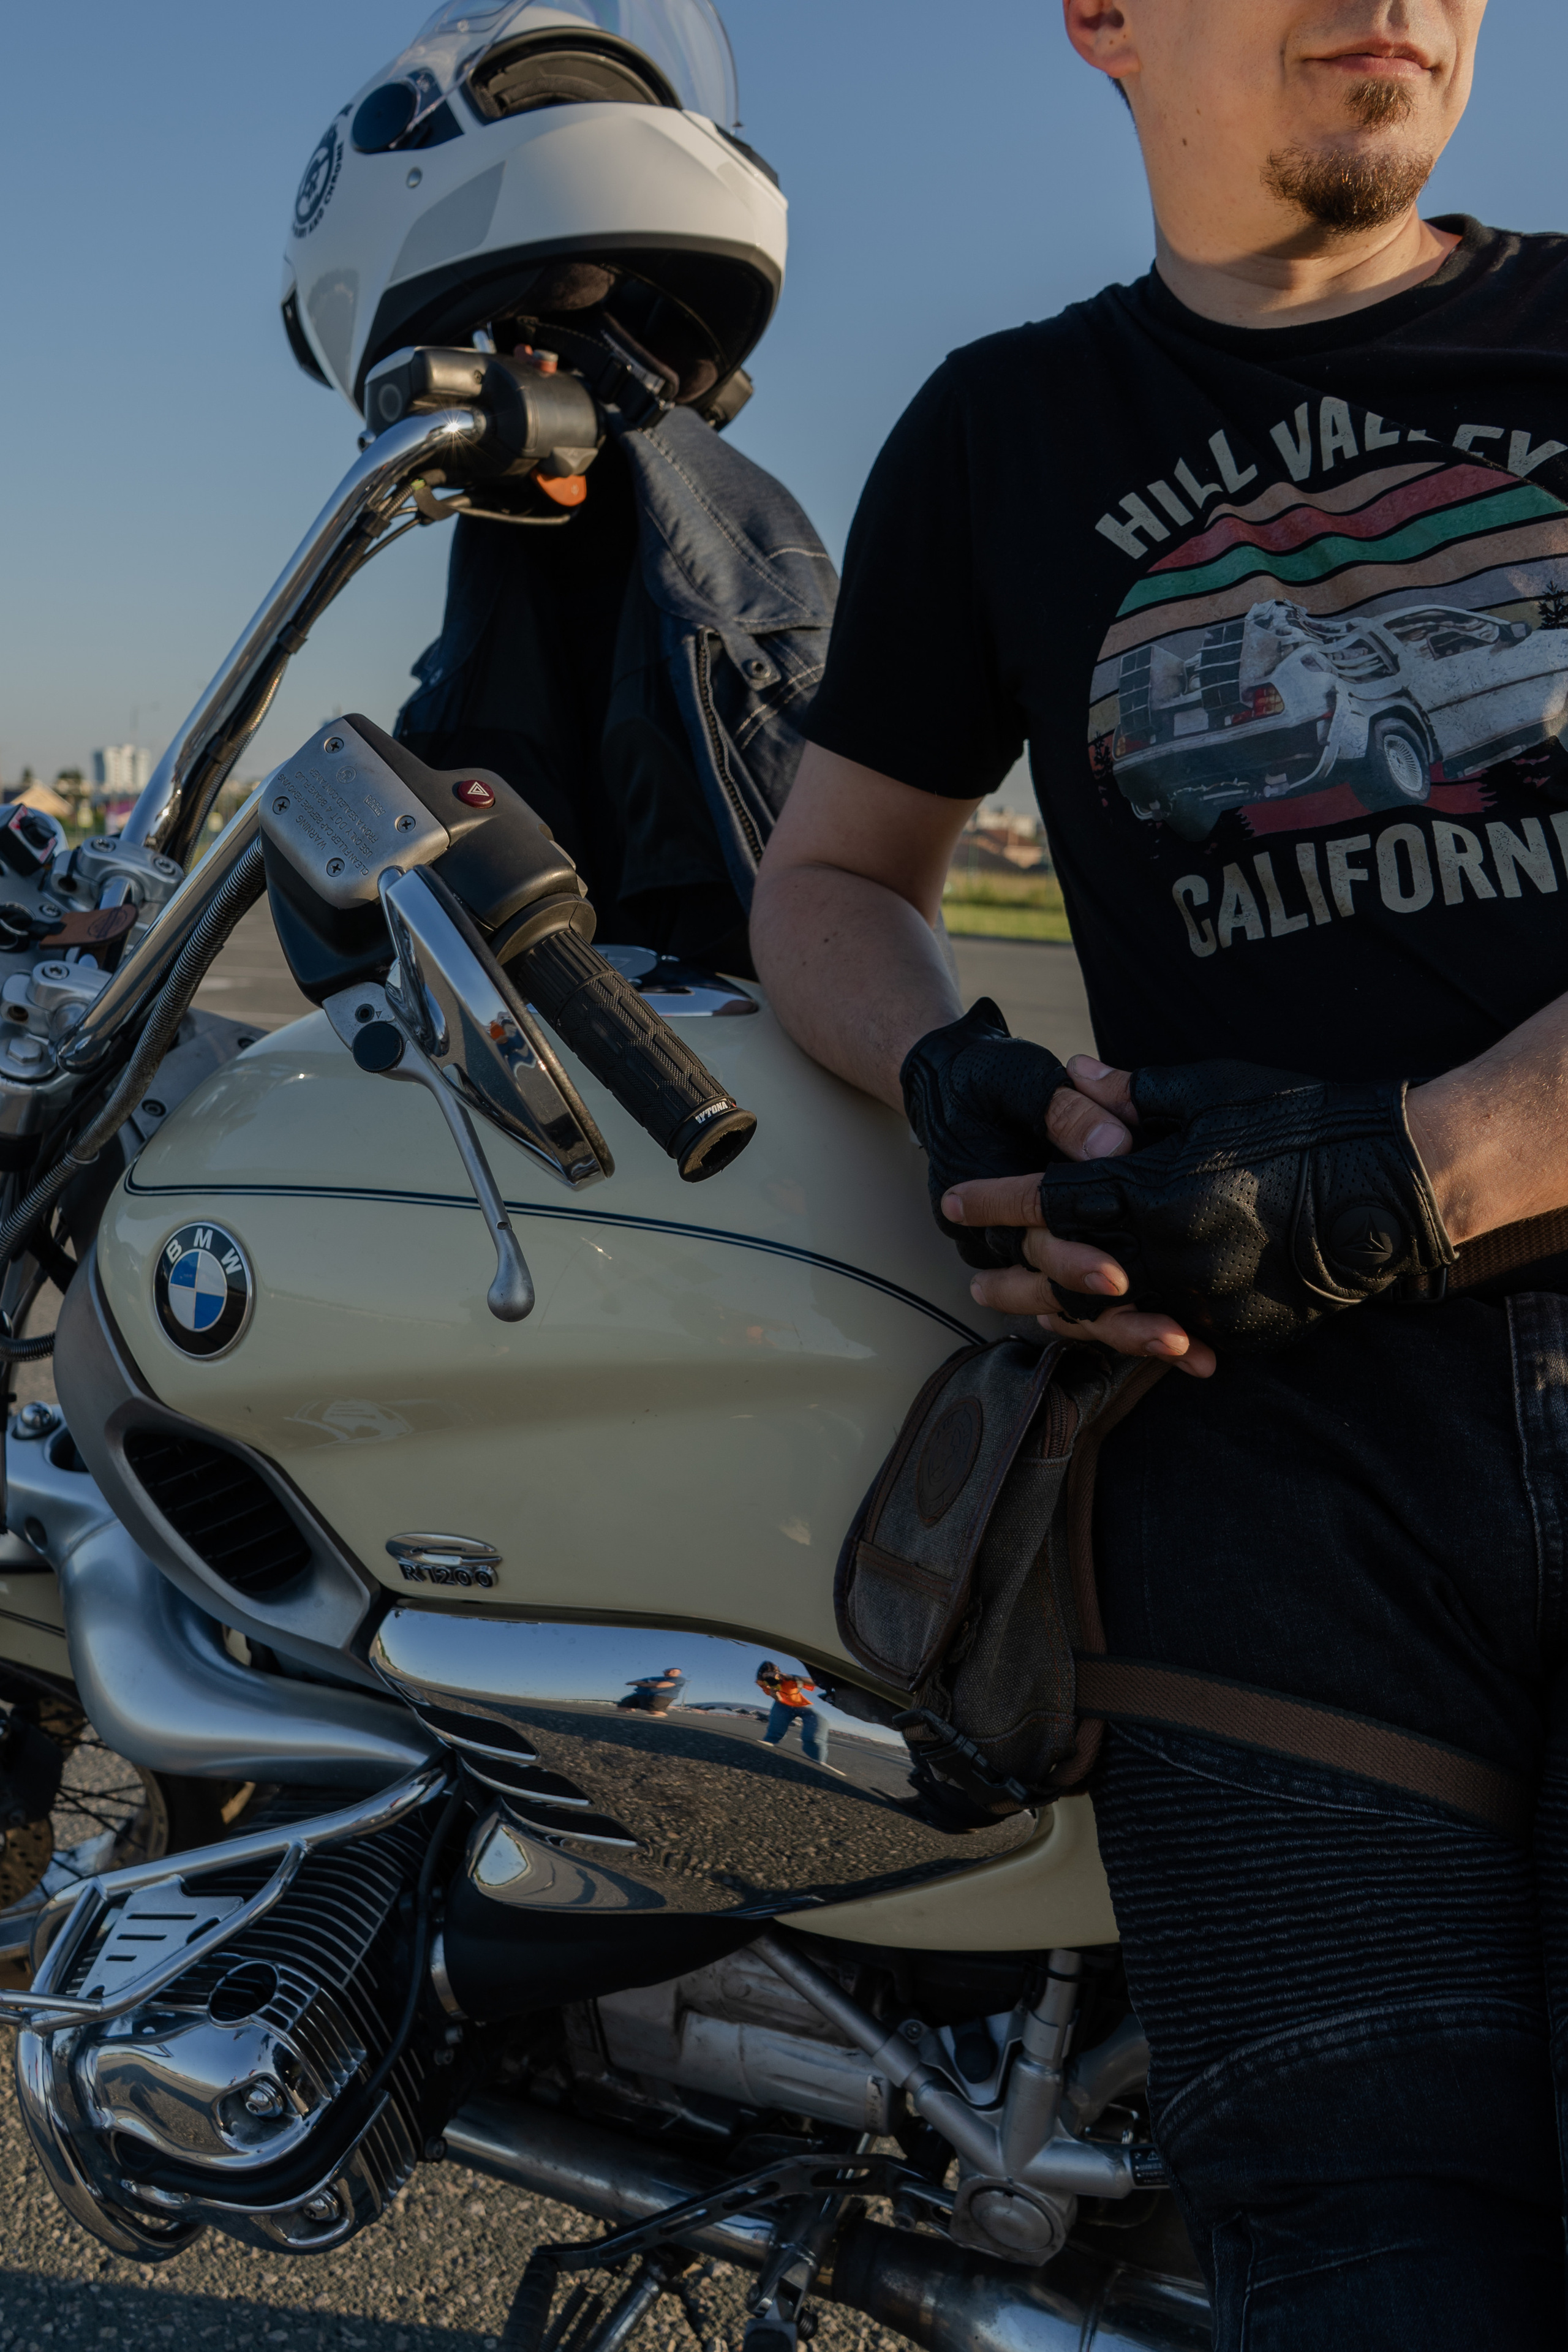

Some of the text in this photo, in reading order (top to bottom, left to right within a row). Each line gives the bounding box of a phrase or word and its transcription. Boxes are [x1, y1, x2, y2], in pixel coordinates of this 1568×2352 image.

[1095, 429, 1258, 559] HILL
[295, 771, 311, 789] FLUID
[309, 767, 339, 799] CONTAINER
[307, 786, 328, 807] BRAKE
[336, 797, 359, 821] SEALED
[278, 774, 369, 876] CLEAN FILLER CAP BEFORE REMOVING
[296, 815, 326, 850] WARNING
[330, 813, 347, 830] DOT
[345, 829, 362, 846] ONLY
[359, 824, 379, 843] FROM
[359, 843, 373, 858] USE
[166, 1227, 243, 1275] BMW
